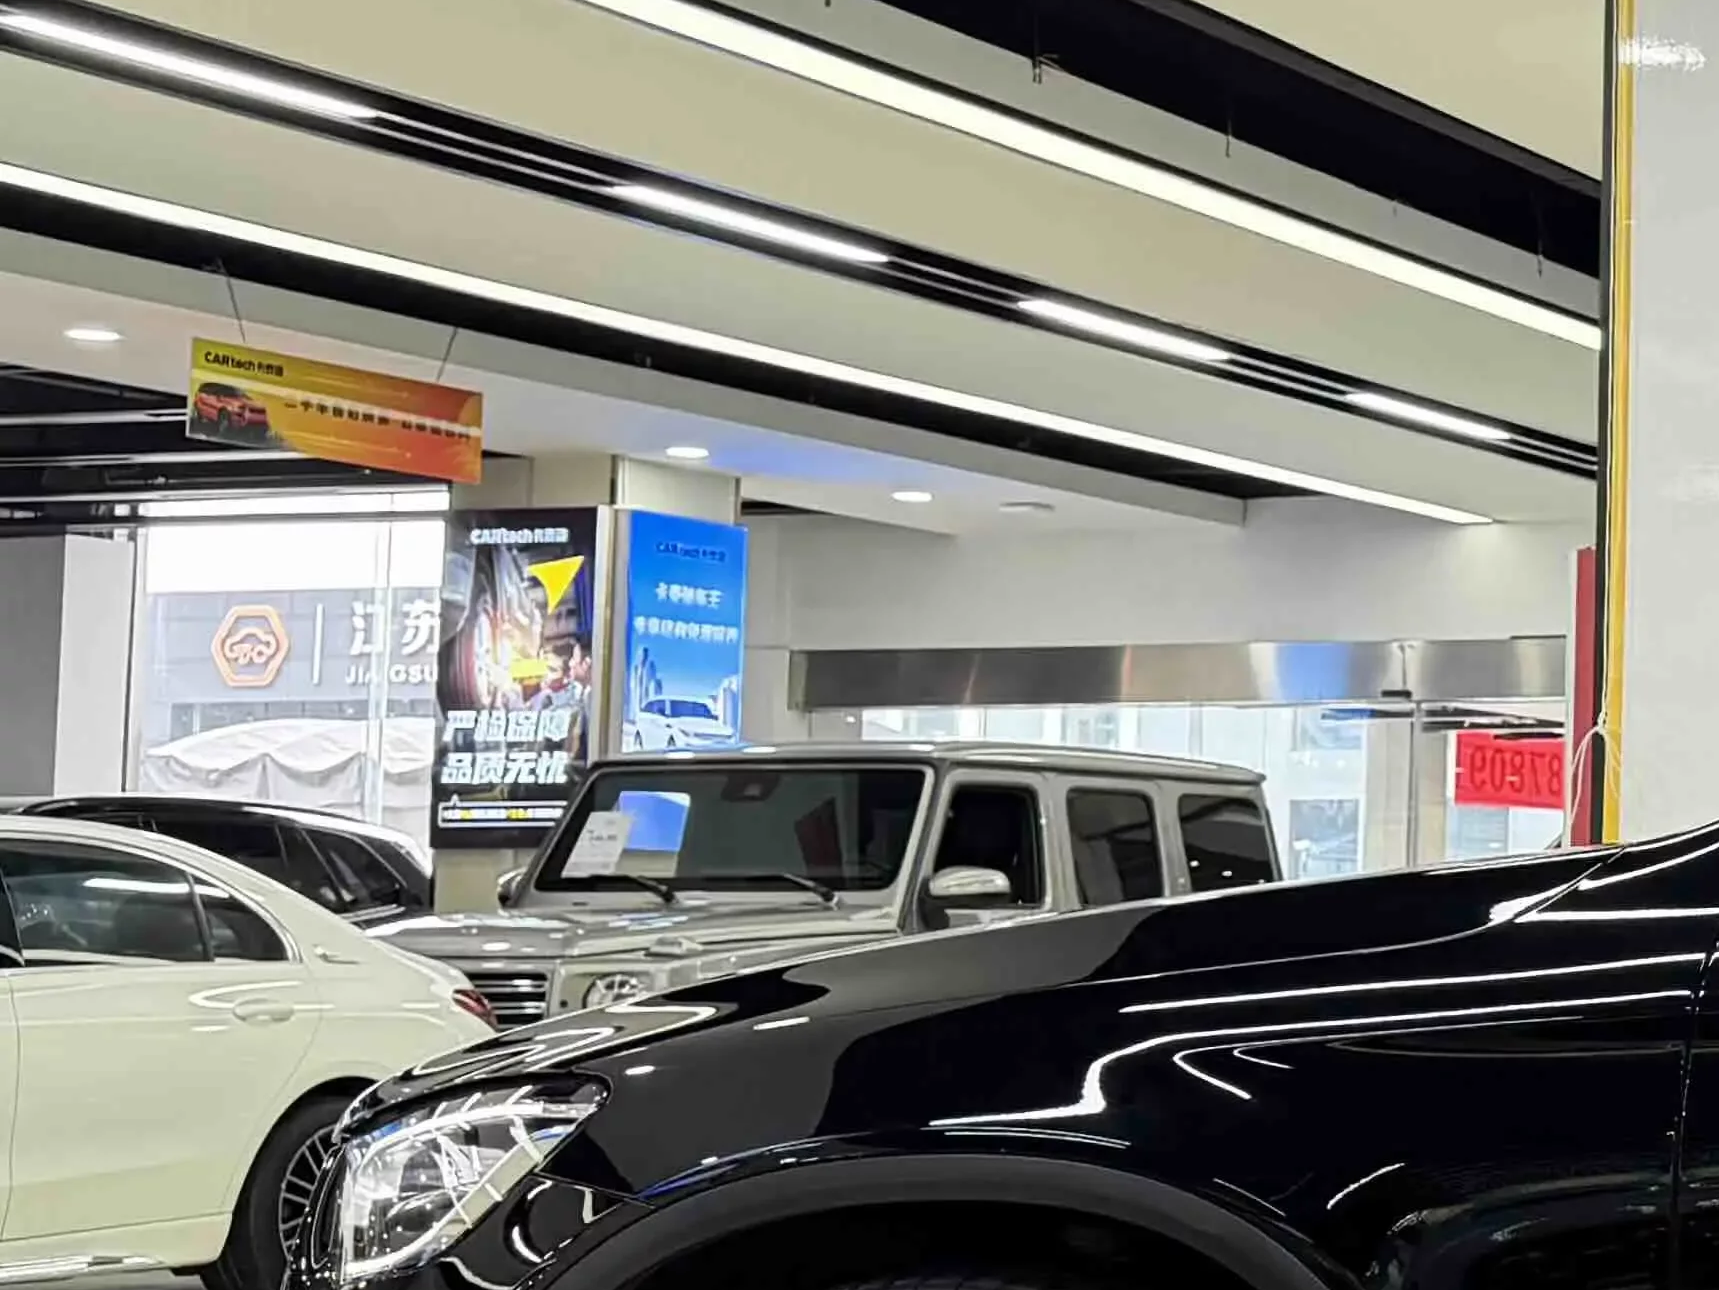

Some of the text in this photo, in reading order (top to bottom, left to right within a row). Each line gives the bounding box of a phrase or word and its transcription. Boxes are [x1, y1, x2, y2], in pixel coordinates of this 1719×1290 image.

[204, 350, 256, 372] CARtech
[440, 750, 569, 785] 品质无忧
